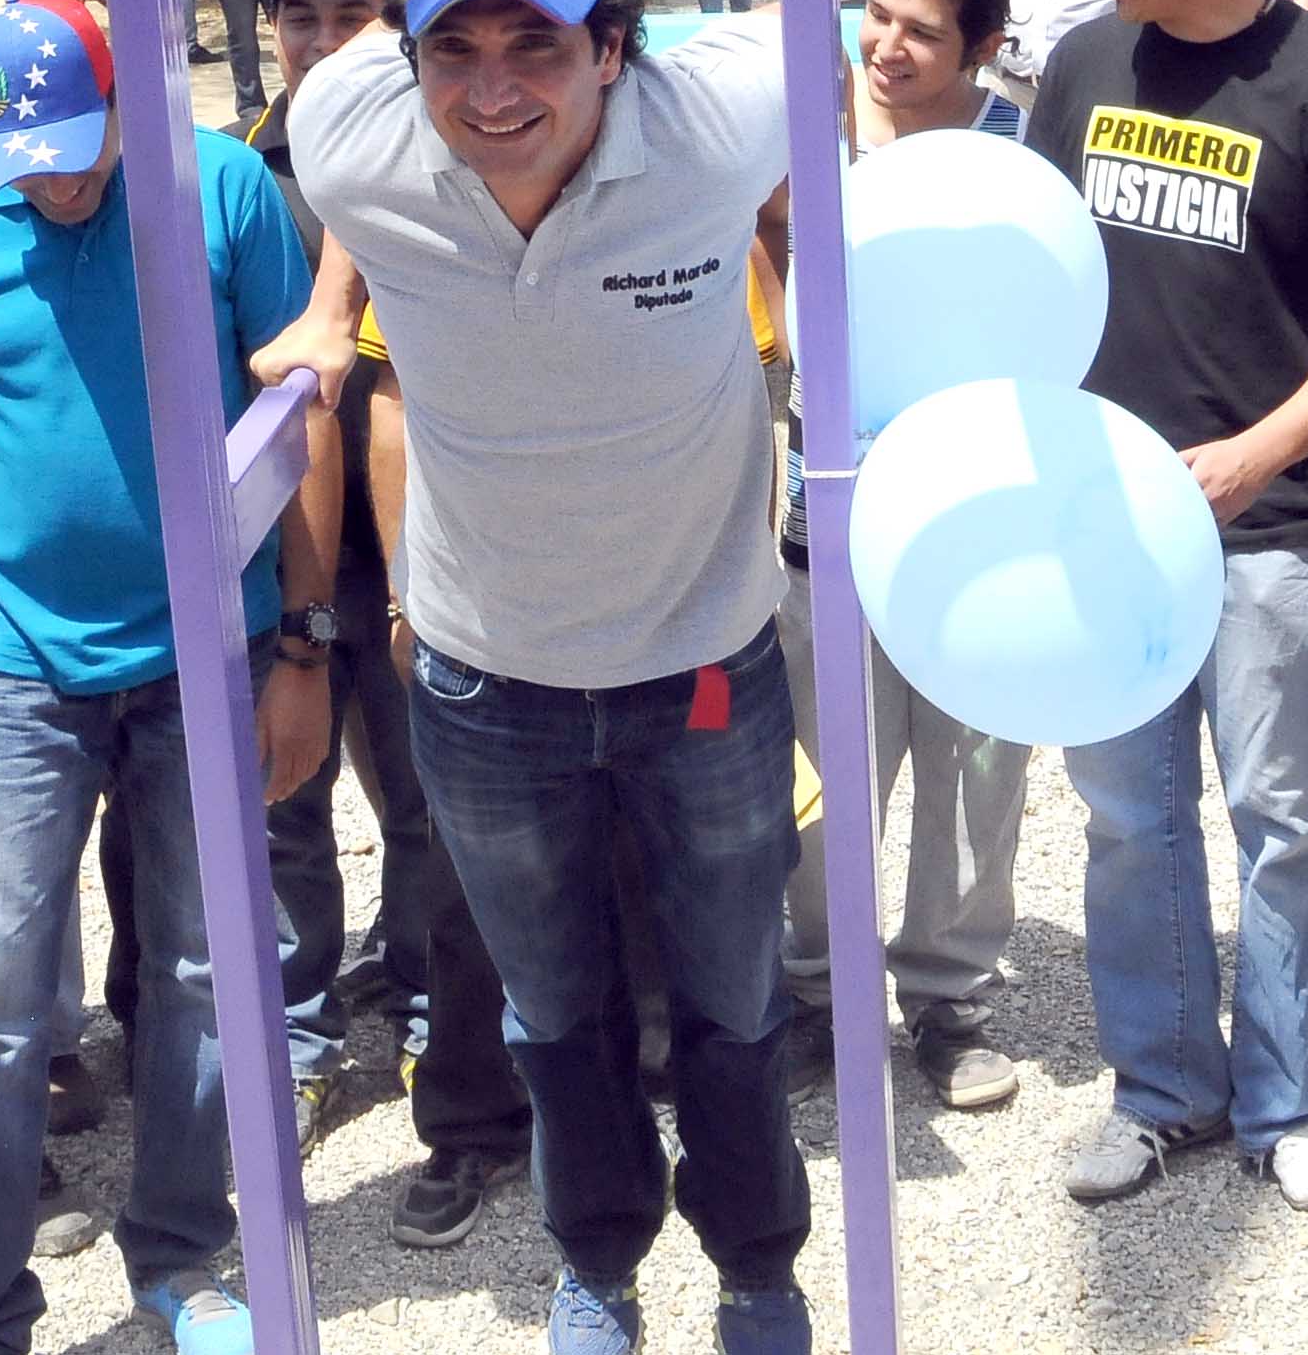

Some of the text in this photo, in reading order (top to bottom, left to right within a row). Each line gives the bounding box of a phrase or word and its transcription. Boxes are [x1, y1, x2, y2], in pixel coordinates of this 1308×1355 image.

[1091, 115, 1252, 178] PRIMERO
[1084, 157, 1240, 245] JUSTICIA
[602, 257, 721, 292] Richard Mardo
[634, 288, 693, 312] Diputado
